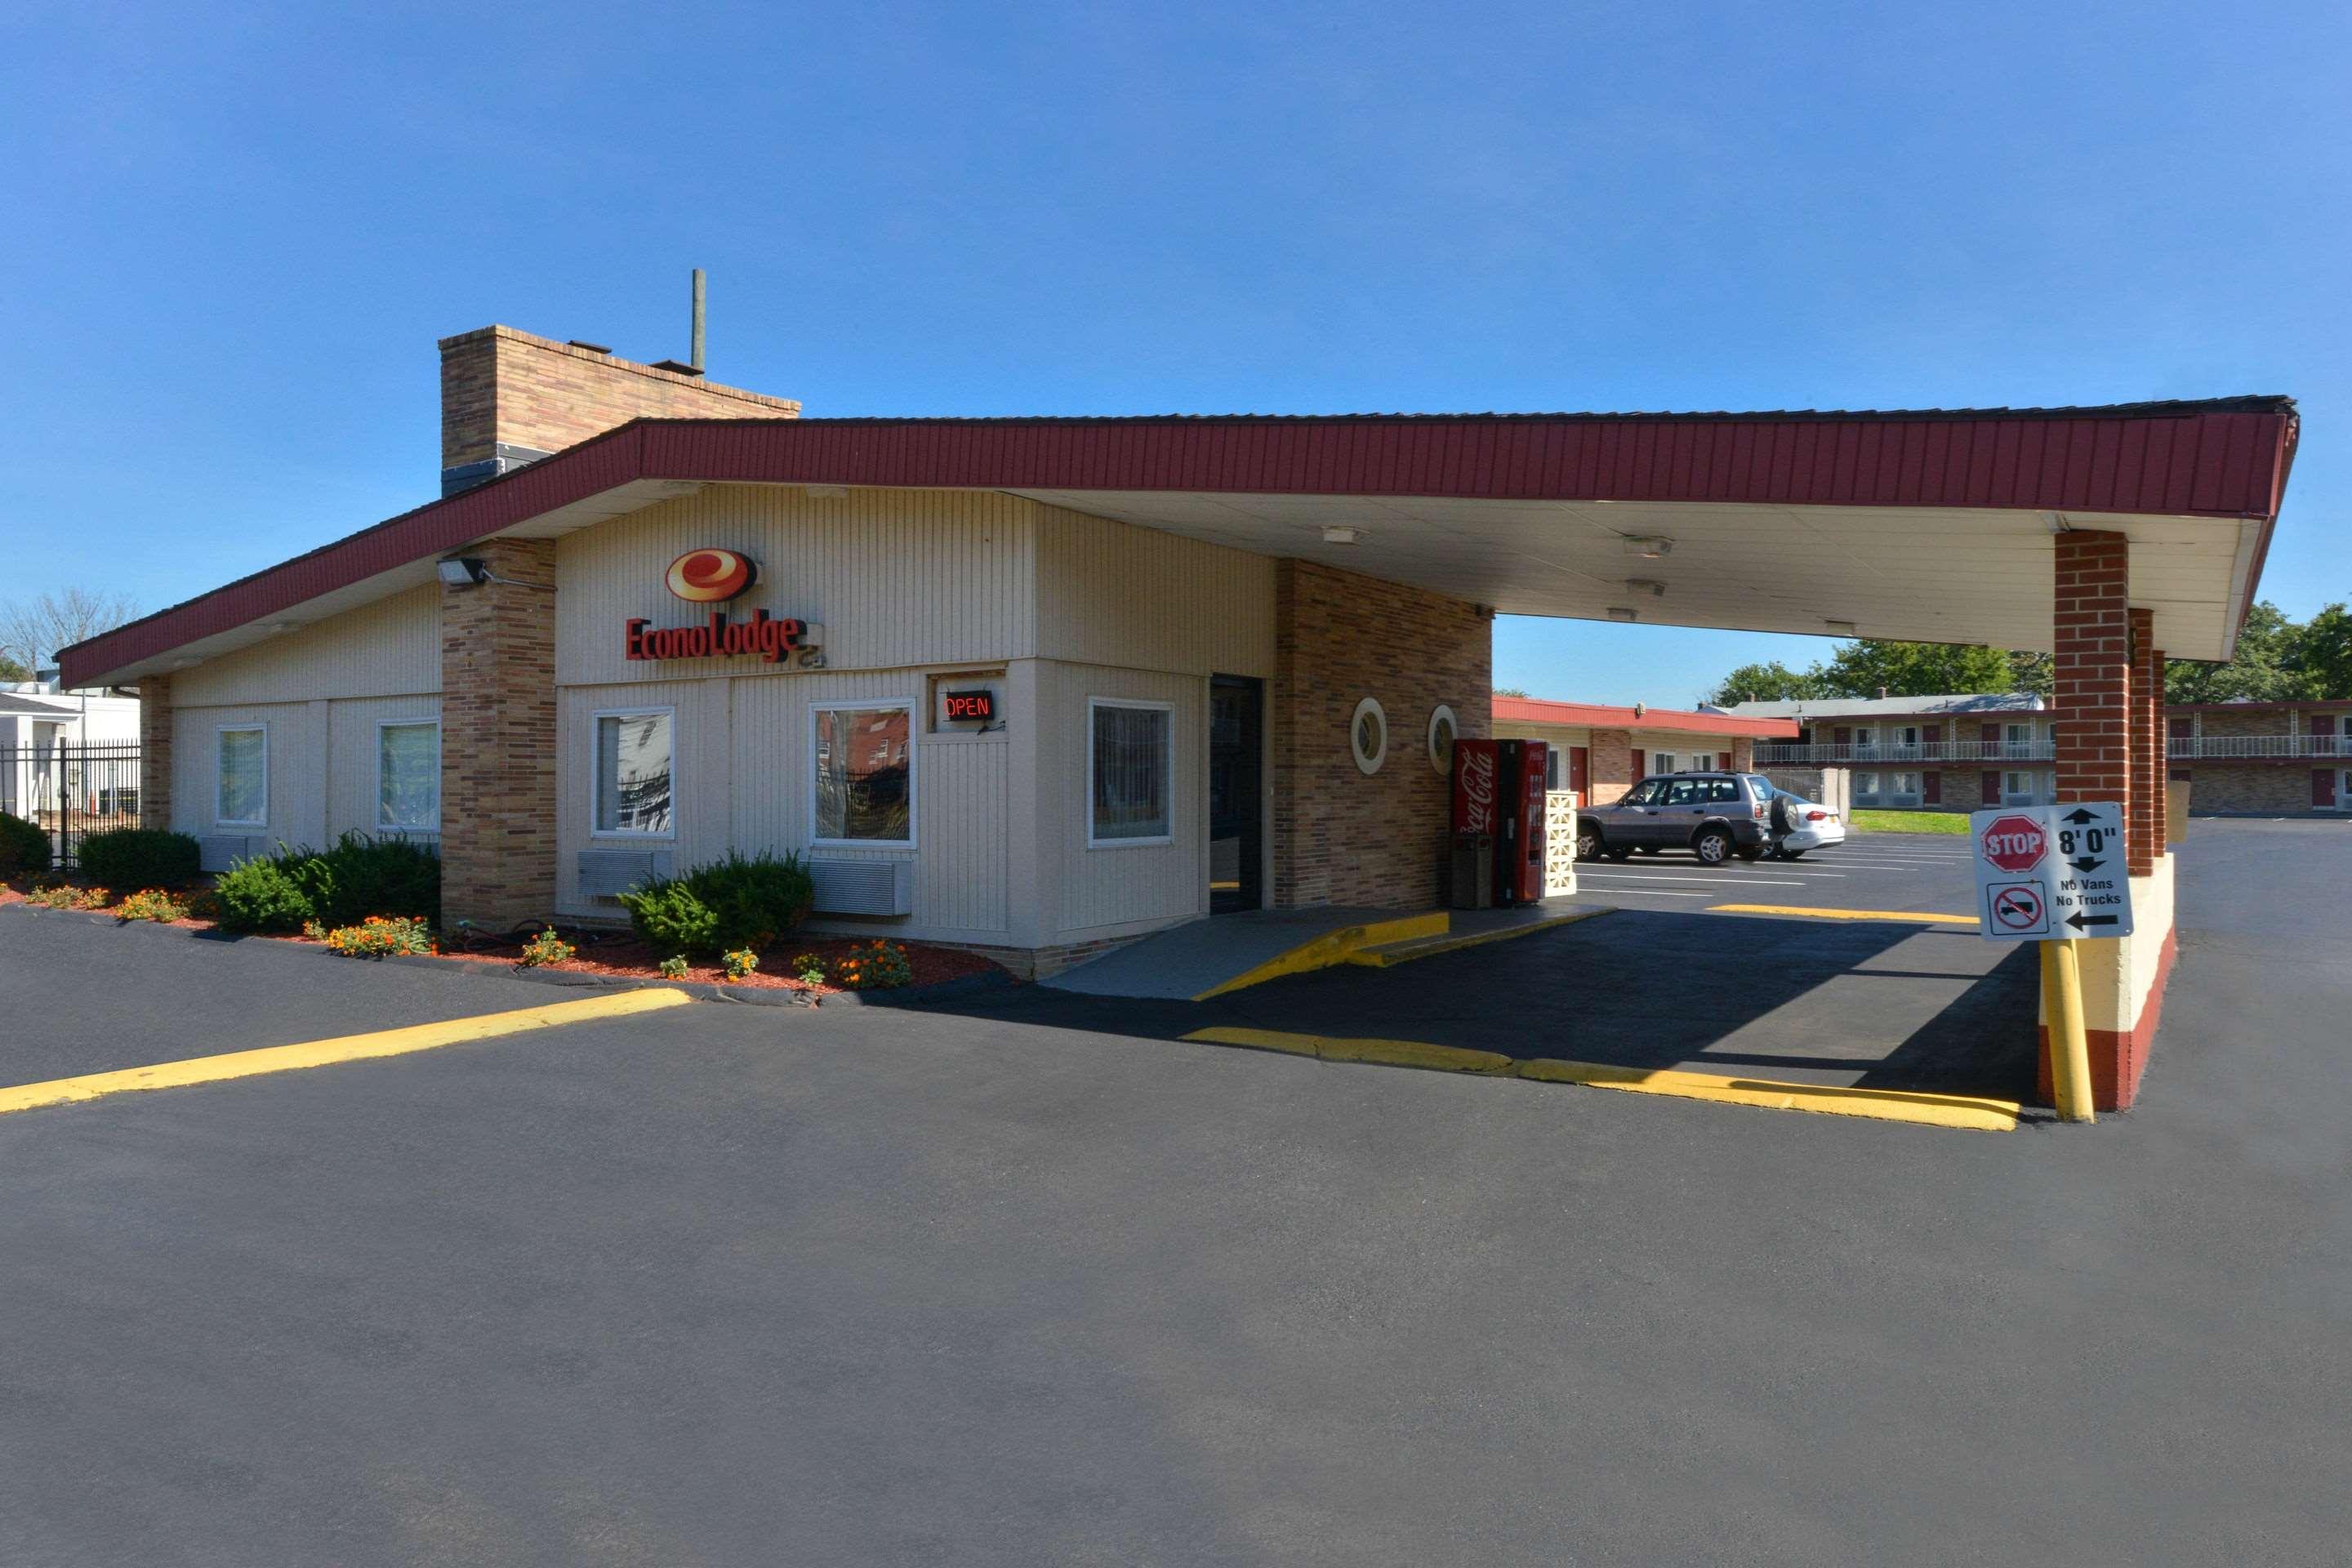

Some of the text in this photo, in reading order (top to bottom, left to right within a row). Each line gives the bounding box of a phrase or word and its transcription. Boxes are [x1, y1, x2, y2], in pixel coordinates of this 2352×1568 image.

[943, 697, 989, 715] OPEN
[1987, 832, 2042, 856] STOP
[2060, 879, 2114, 891] No Vans
[2056, 893, 2122, 906] No Trucks
